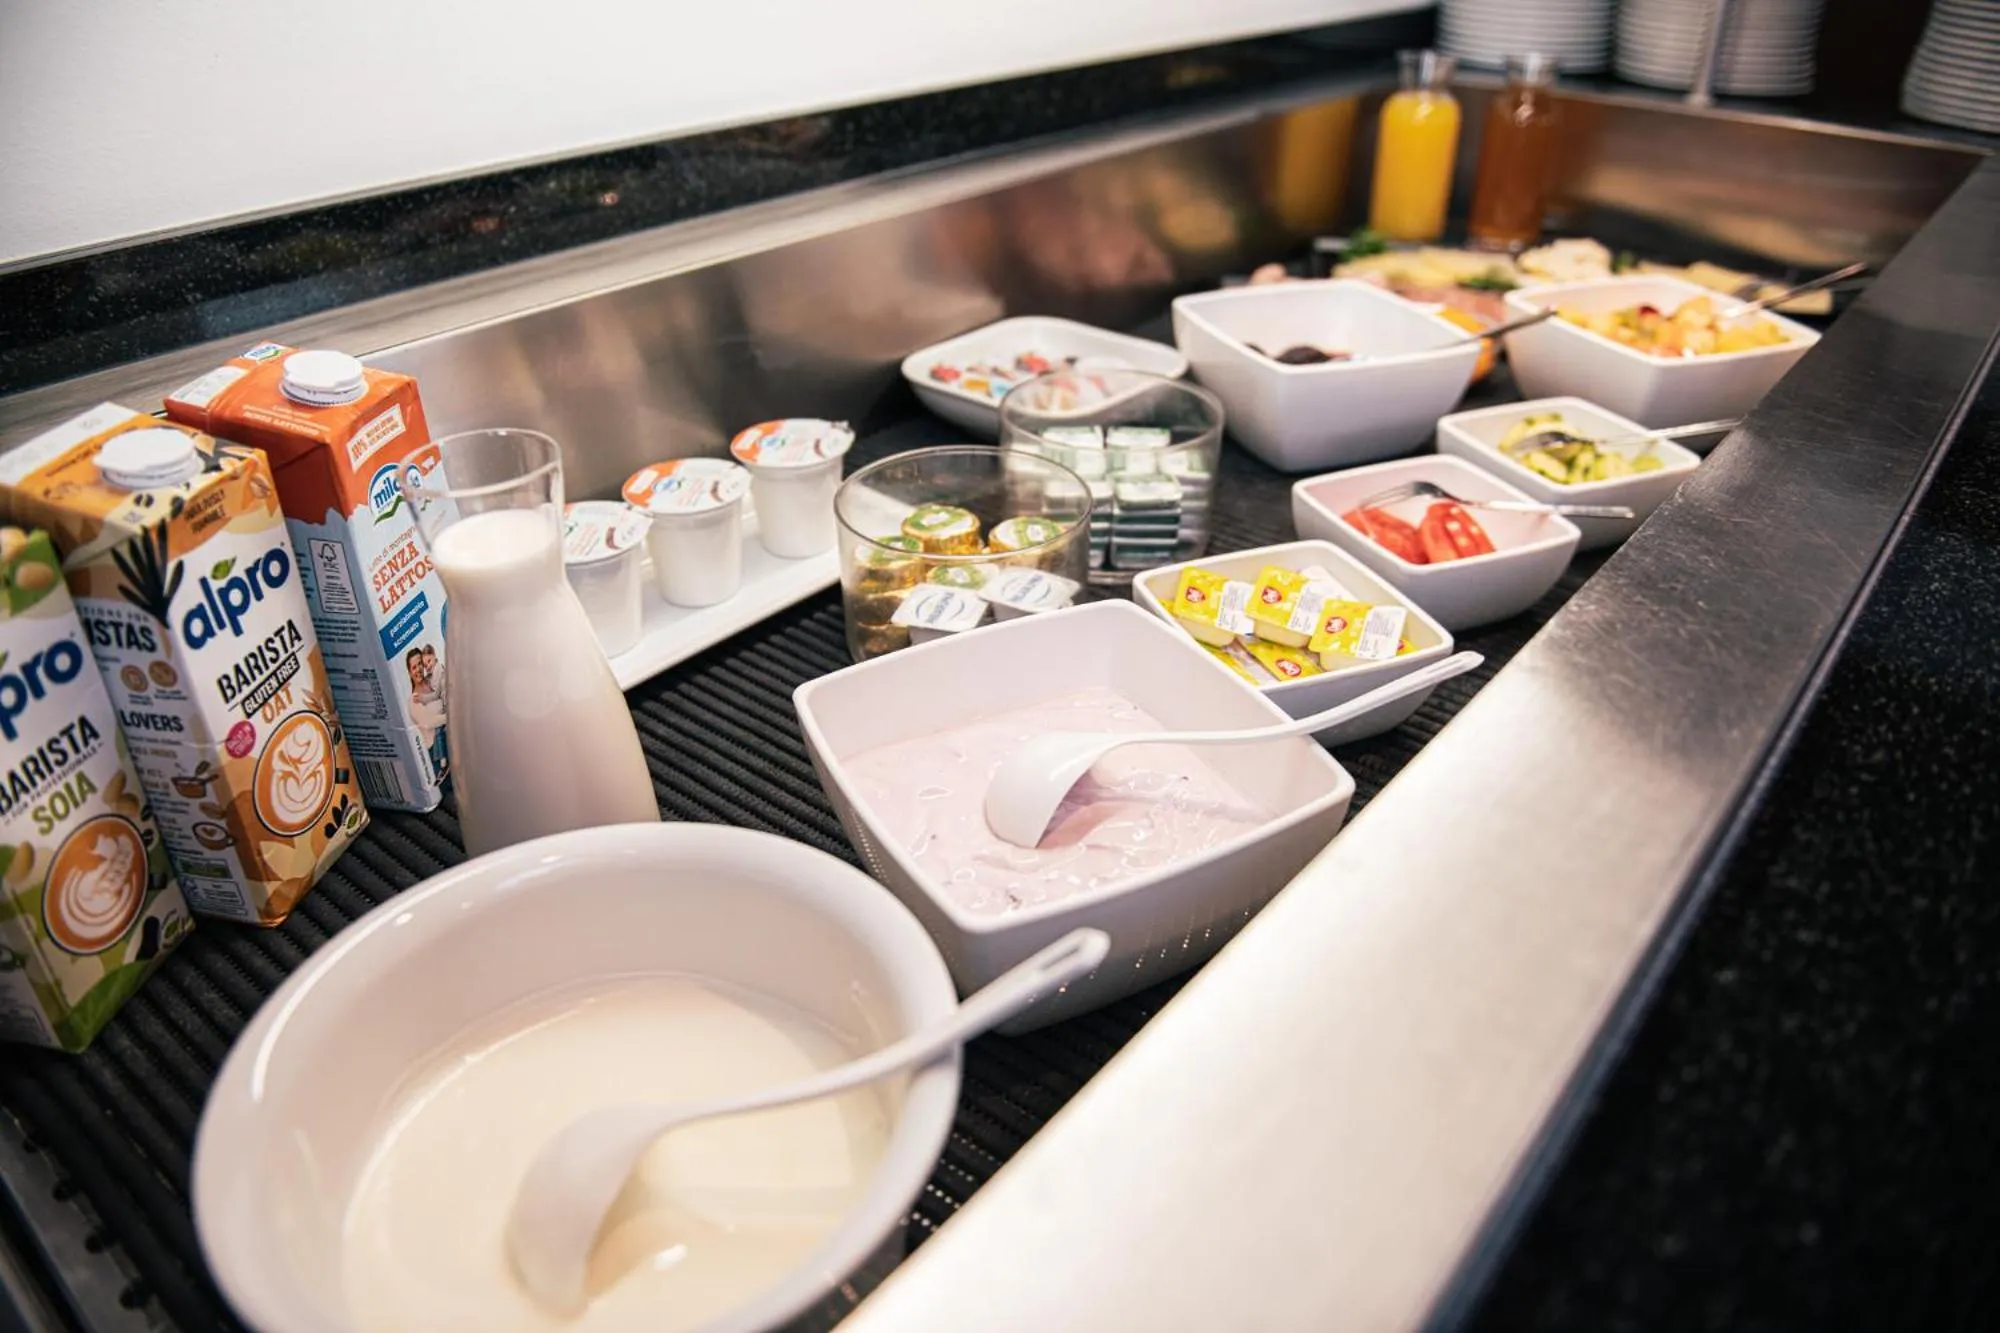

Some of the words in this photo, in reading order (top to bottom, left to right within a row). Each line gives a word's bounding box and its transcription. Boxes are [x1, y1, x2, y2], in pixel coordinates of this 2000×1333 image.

[372, 541, 420, 593] SENZA
[183, 547, 290, 650] alpro
[216, 619, 303, 704] BARISTA
[244, 674, 280, 715] GLUTEN
[277, 655, 299, 683] FREE
[120, 708, 184, 732] LOVERS
[261, 683, 293, 724] OAT
[31, 770, 97, 836] SOIA
